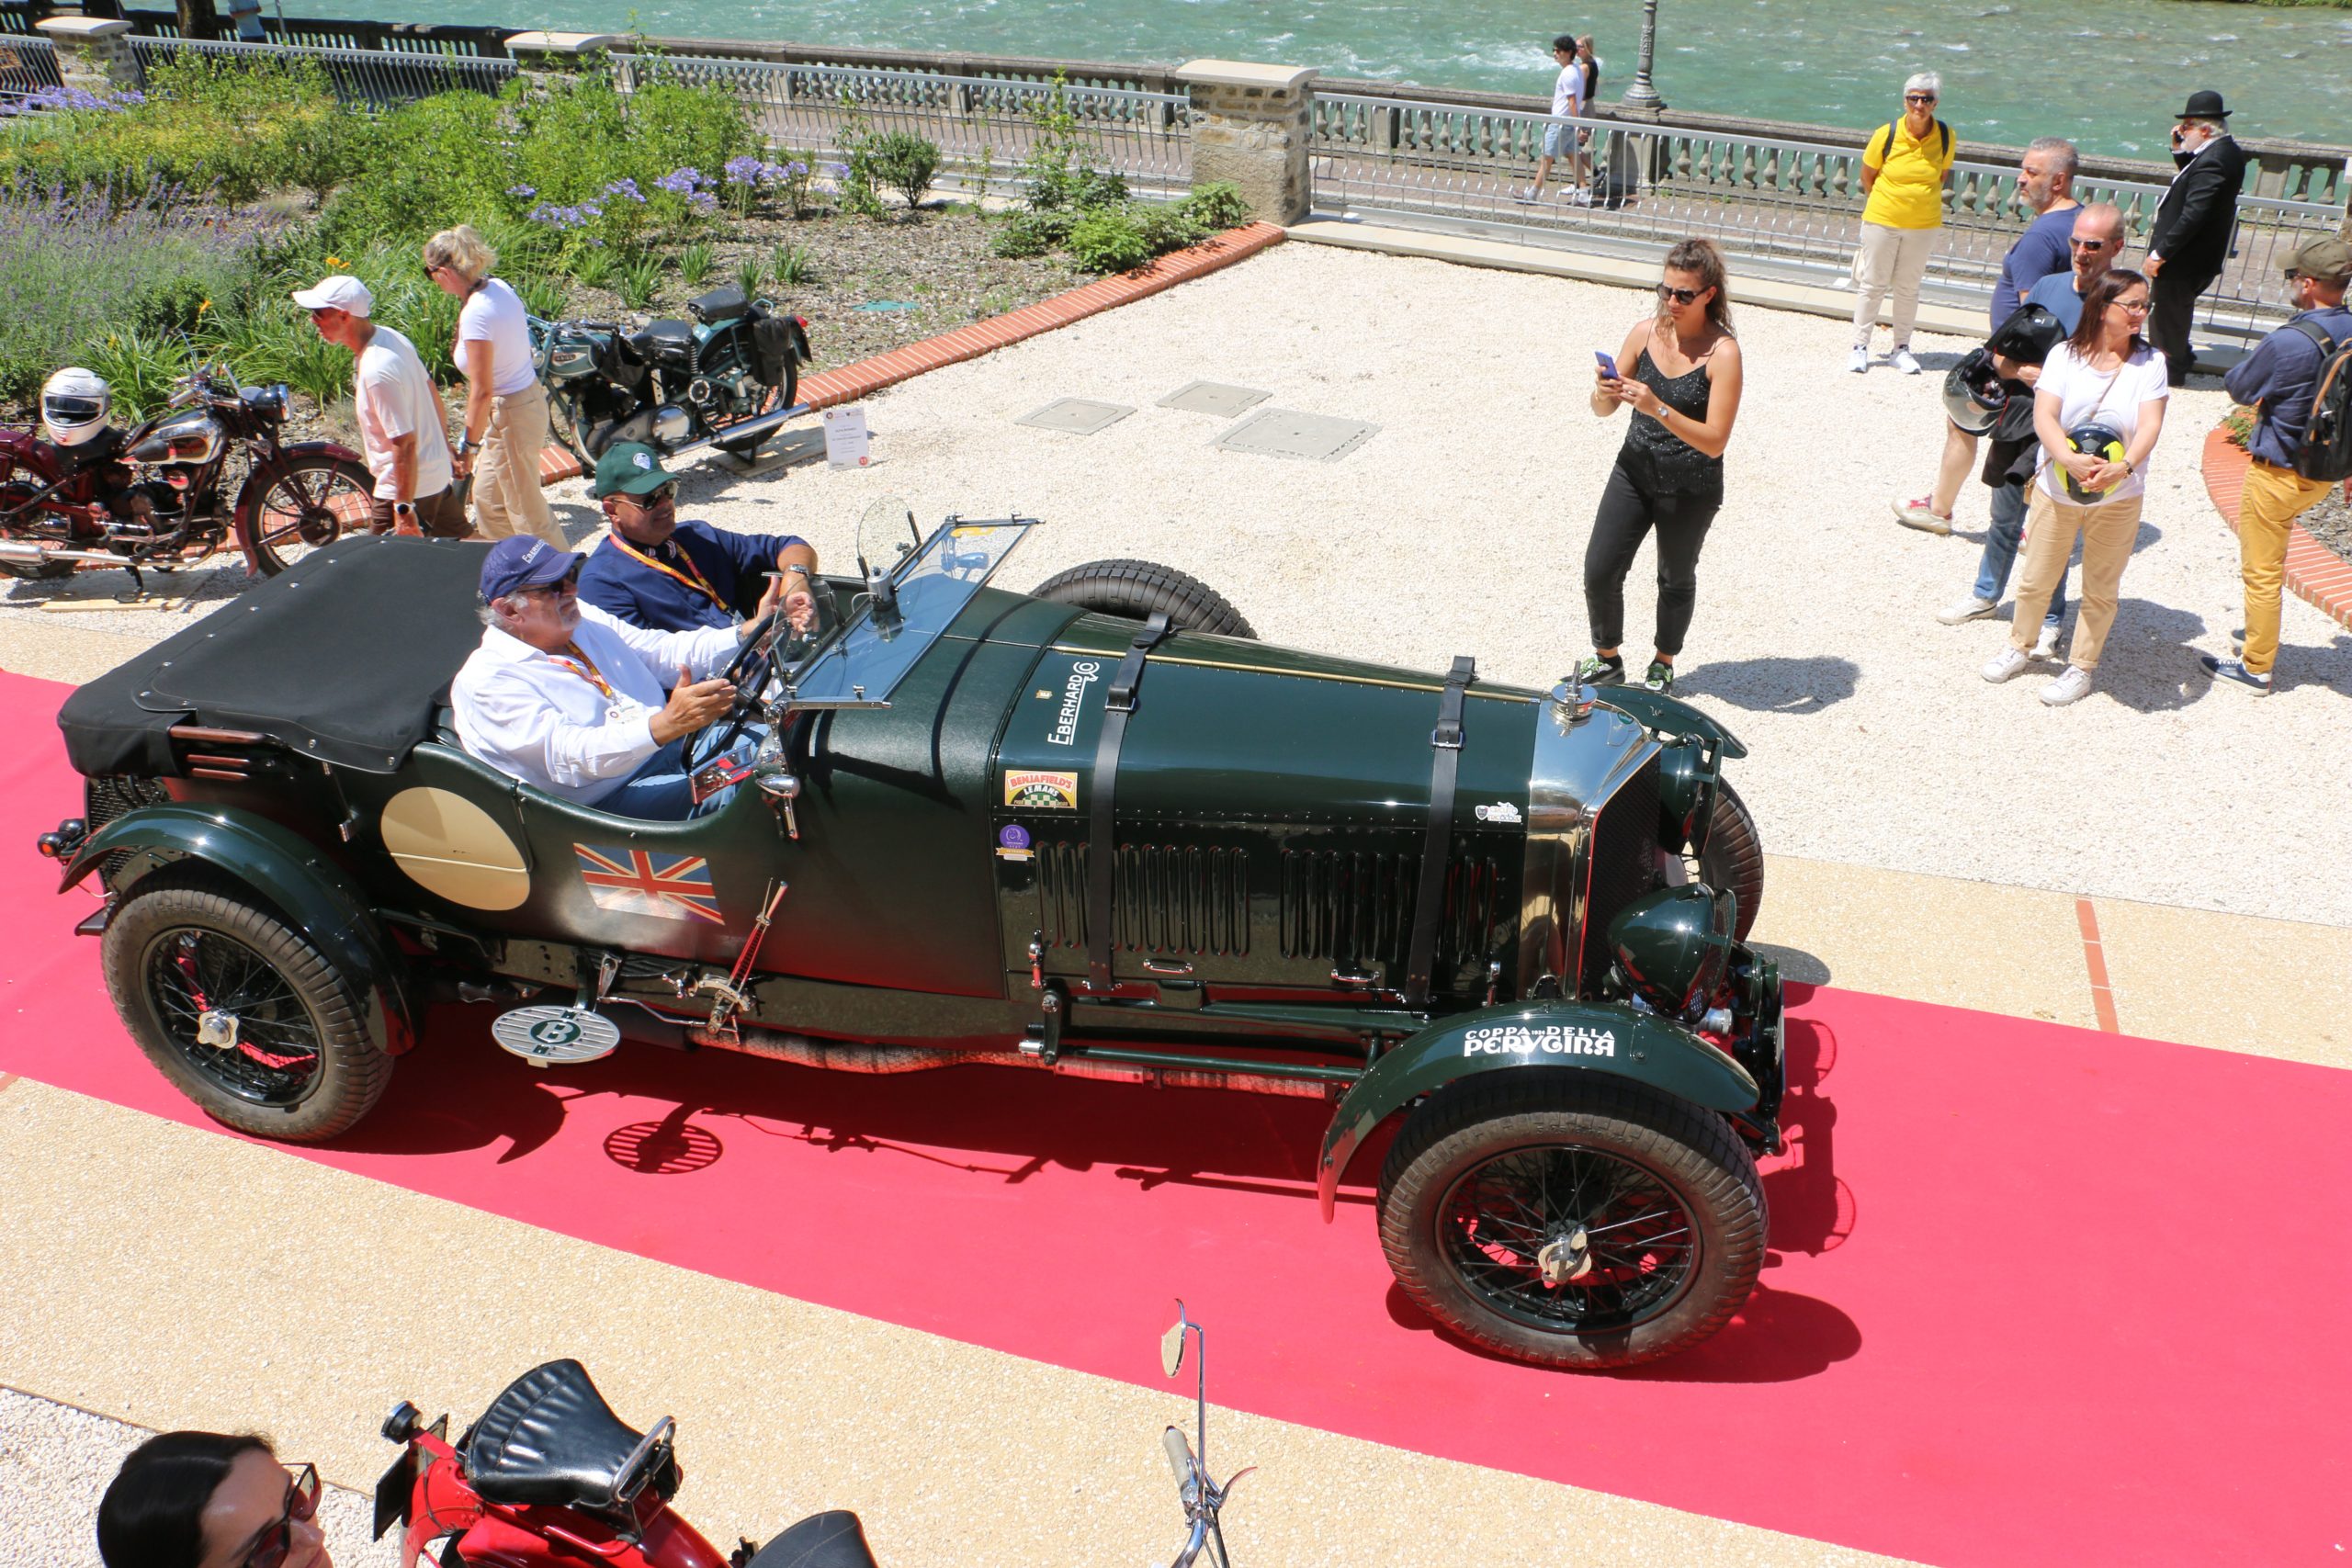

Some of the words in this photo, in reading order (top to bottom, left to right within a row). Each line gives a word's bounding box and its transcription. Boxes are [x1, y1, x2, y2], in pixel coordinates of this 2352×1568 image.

[1047, 674, 1083, 745] EBERHARD
[1010, 774, 1073, 789] BENJAFIELD'S
[537, 1021, 574, 1043] B
[1464, 1026, 1531, 1040] COPPA
[1546, 1025, 1614, 1040] DELLA
